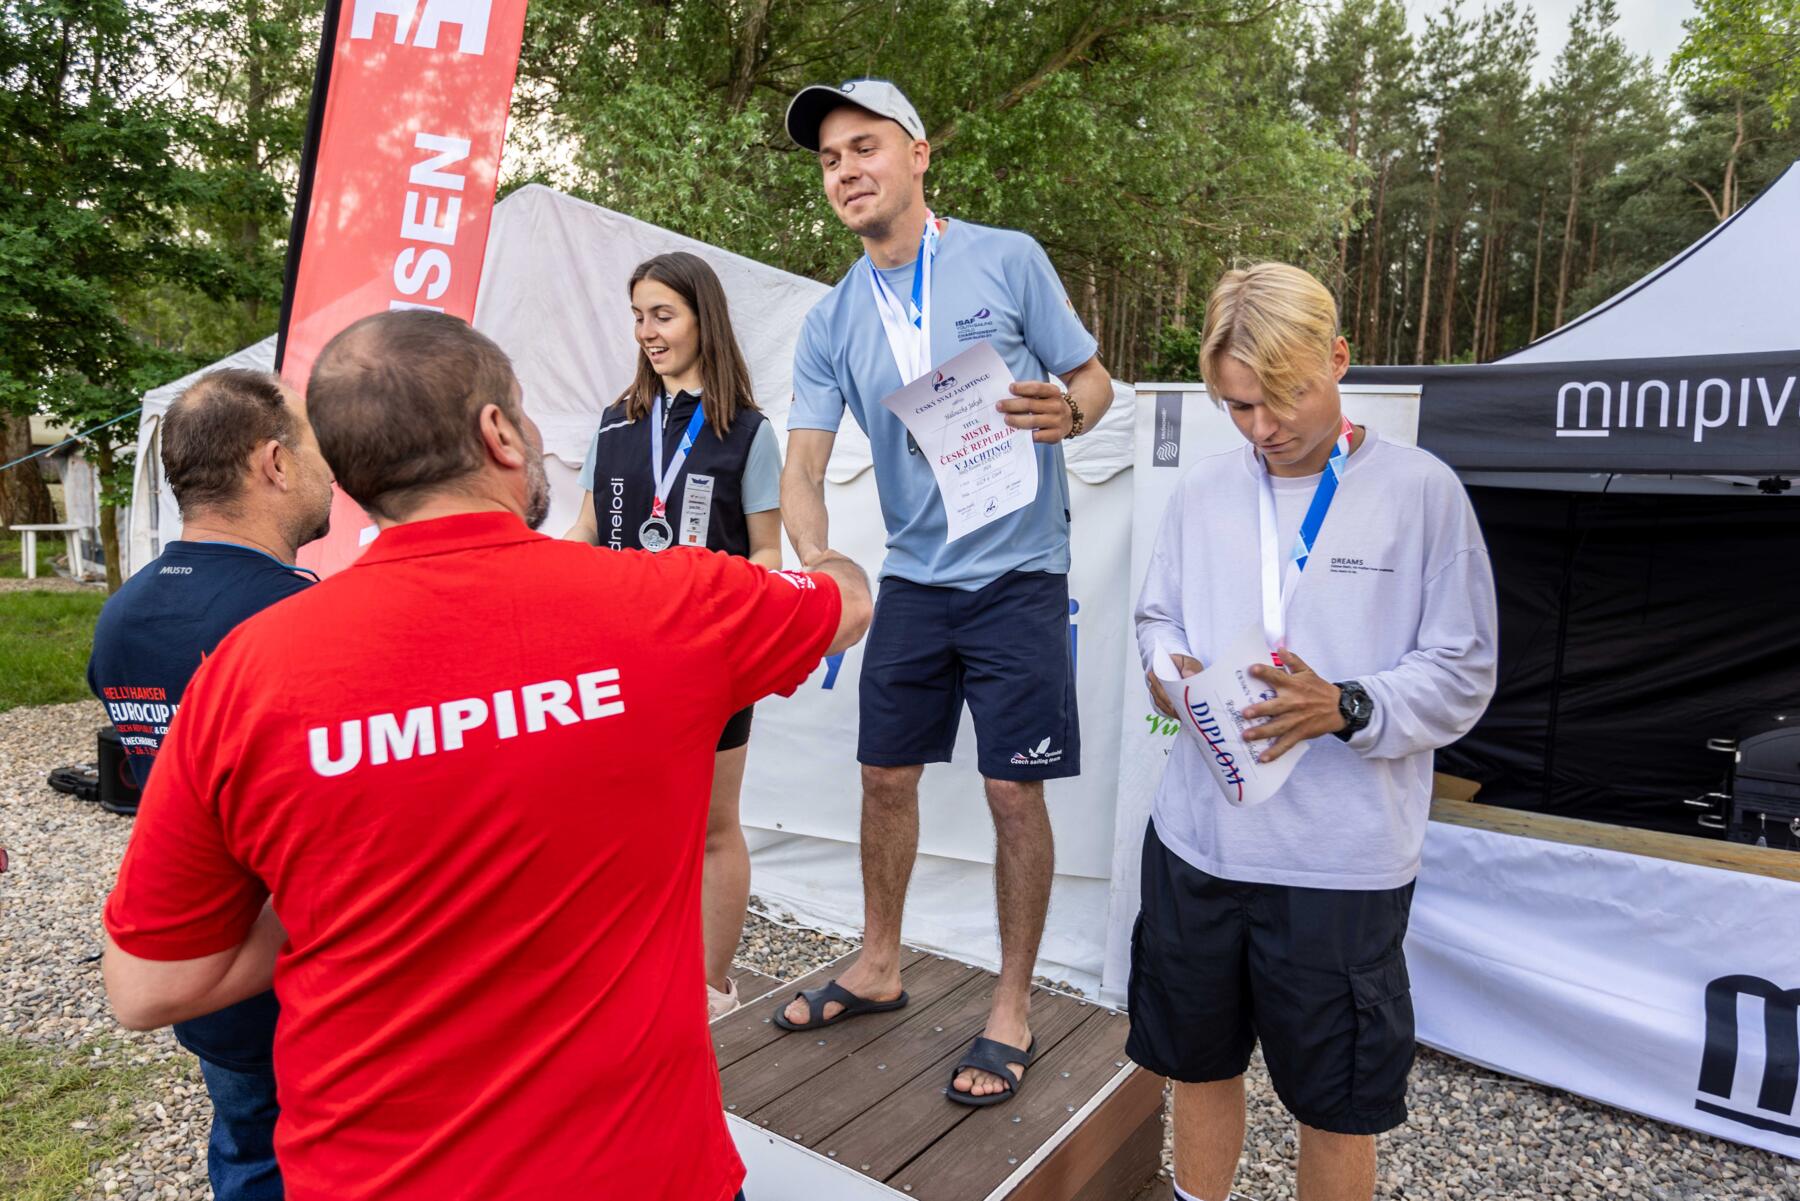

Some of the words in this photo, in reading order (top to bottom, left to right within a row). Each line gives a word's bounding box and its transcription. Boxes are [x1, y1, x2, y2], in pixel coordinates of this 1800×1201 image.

[389, 132, 472, 313] SEN
[955, 317, 976, 327] ISAF
[953, 372, 991, 395] JACHTINGU
[1556, 376, 1800, 442] minipiv
[961, 423, 991, 442] MISTR
[940, 443, 970, 466] ČESKÉ
[963, 438, 1013, 469] JACHTINGU
[159, 566, 193, 576] MUSTO
[1331, 557, 1364, 566] DREAMS
[129, 687, 167, 701] HANSEN
[109, 702, 170, 723] EUROCUP
[308, 668, 625, 777] UMPIRE
[1010, 757, 1030, 765] Czech
